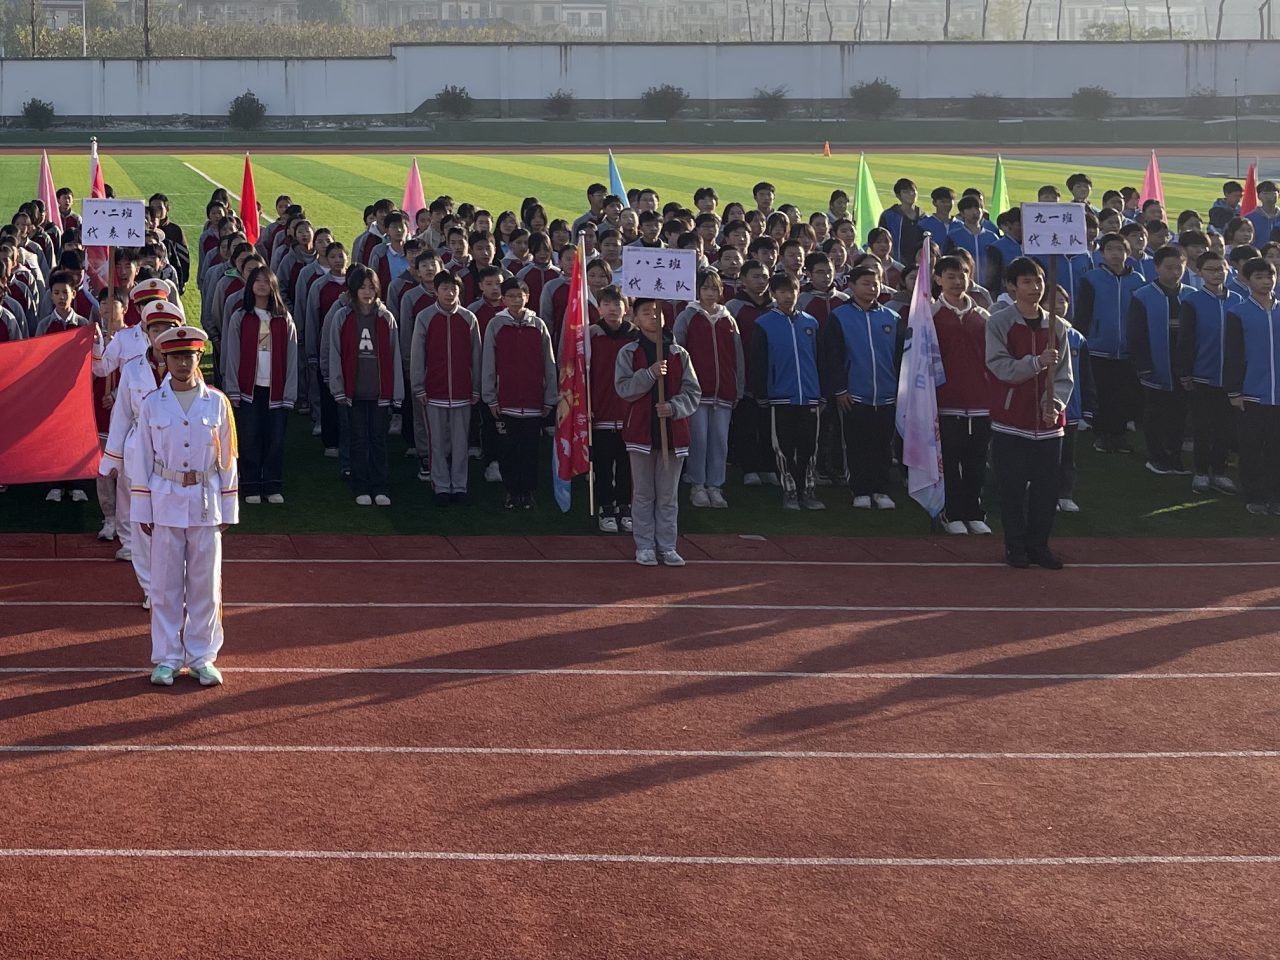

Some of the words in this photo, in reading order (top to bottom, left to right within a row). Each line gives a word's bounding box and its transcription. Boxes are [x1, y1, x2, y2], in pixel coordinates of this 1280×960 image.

[93, 207, 132, 218] 八二班
[1034, 211, 1073, 224] 九一班
[86, 226, 140, 239] 代表队
[1027, 233, 1083, 246] 代表队
[636, 257, 681, 270] 八三班
[628, 277, 691, 292] 代表队
